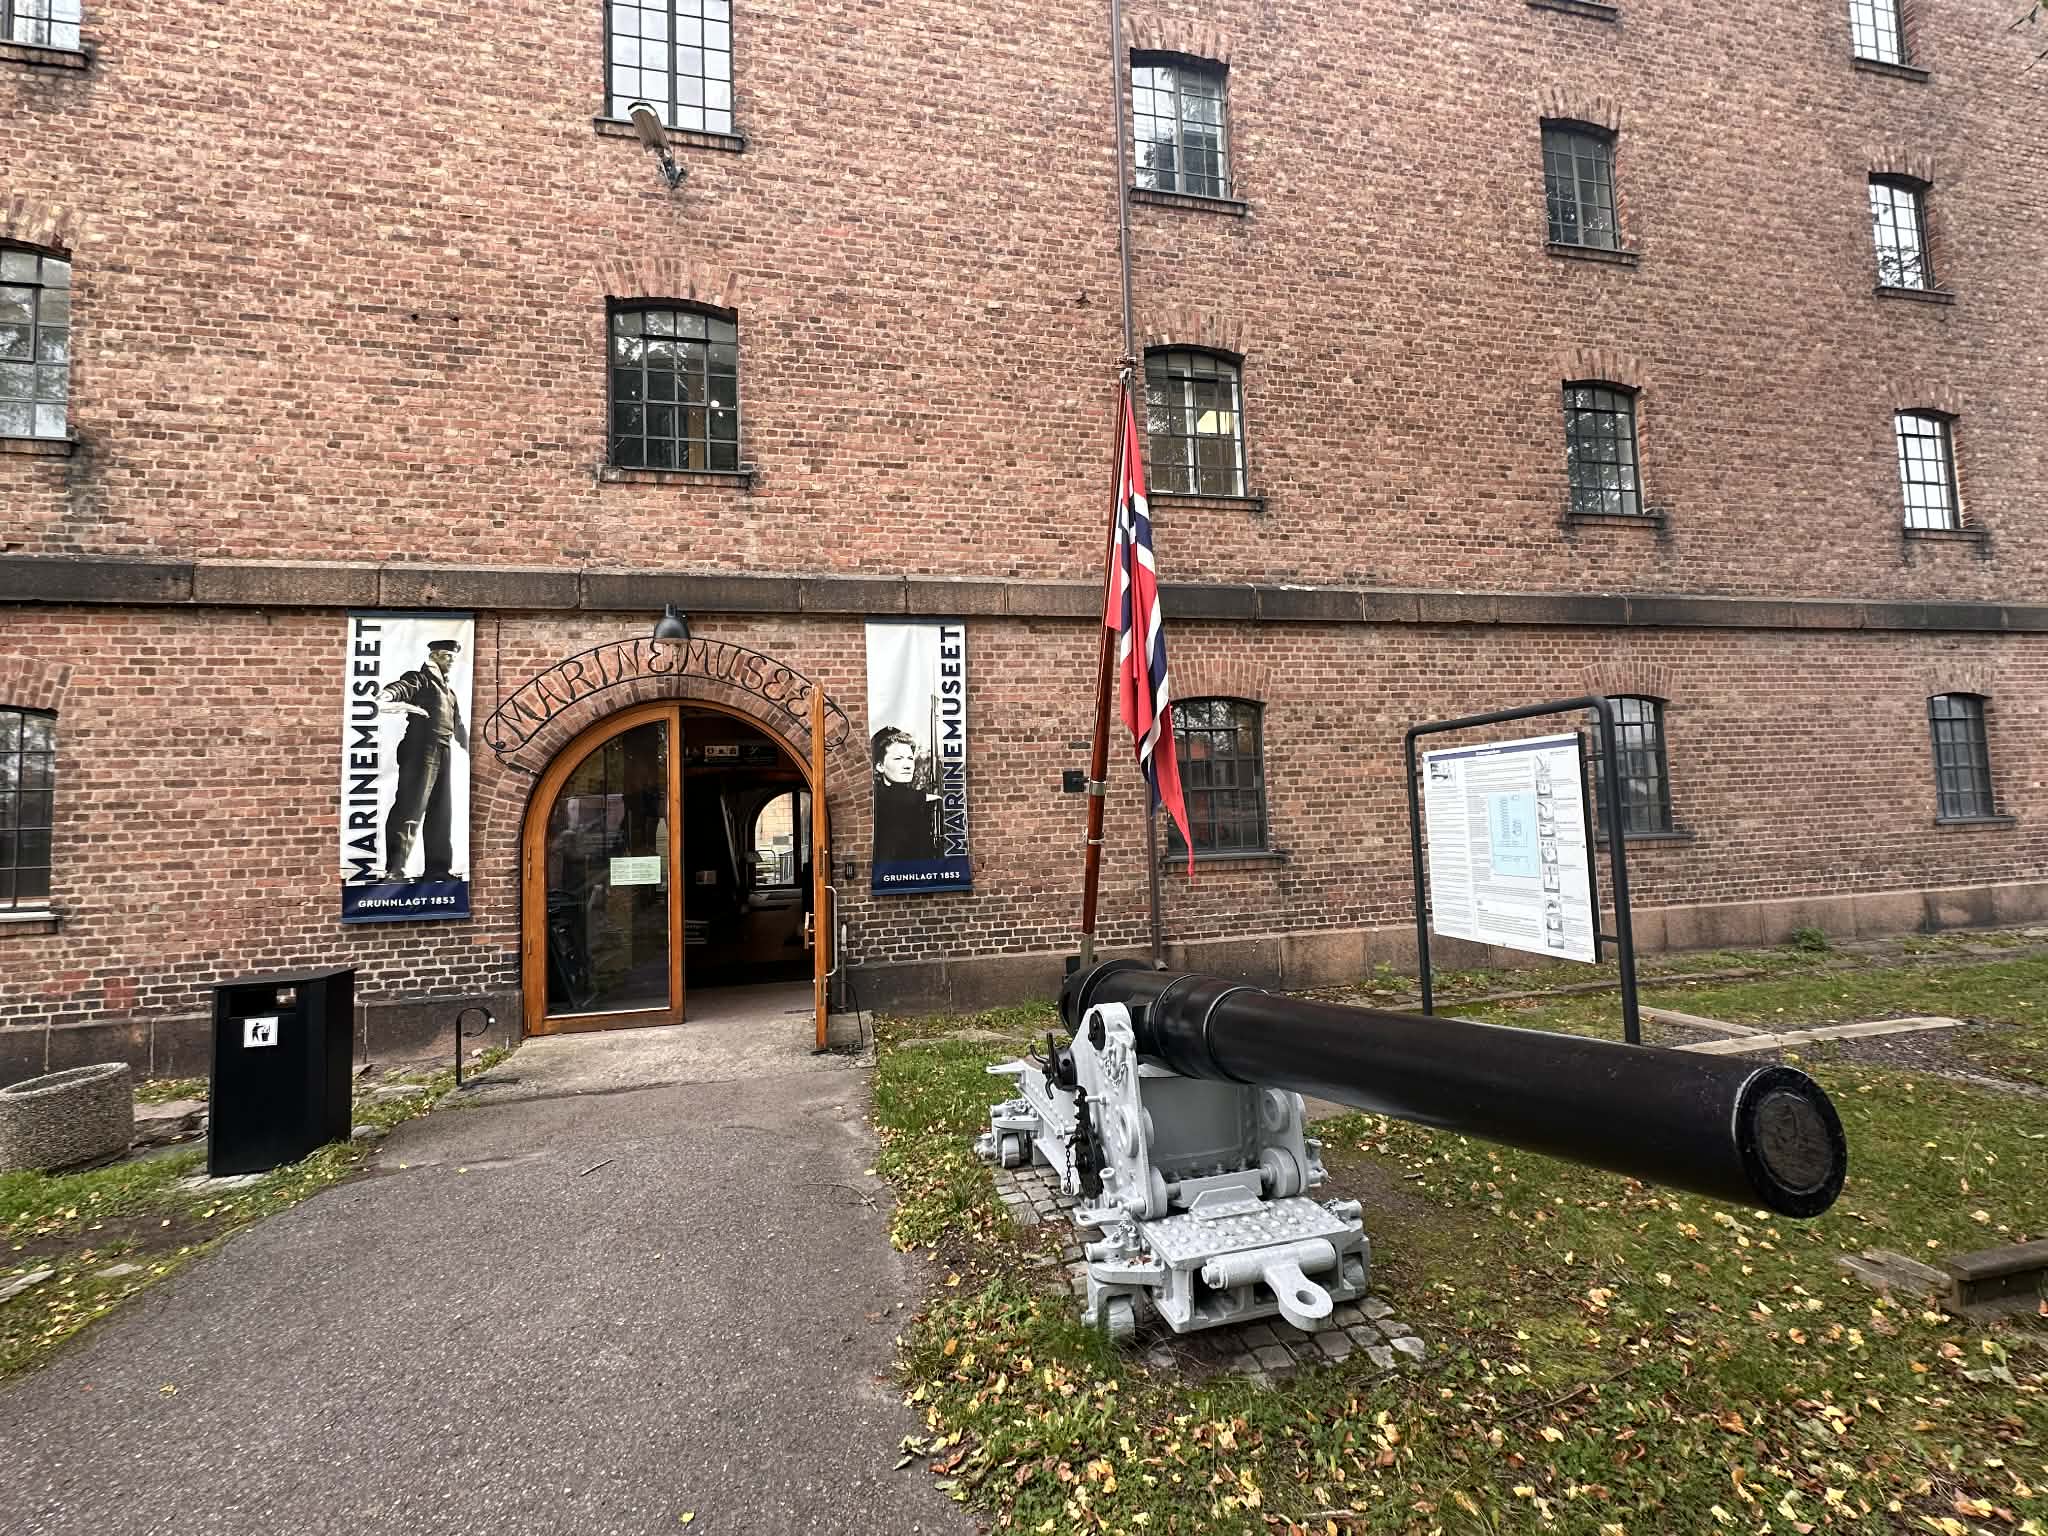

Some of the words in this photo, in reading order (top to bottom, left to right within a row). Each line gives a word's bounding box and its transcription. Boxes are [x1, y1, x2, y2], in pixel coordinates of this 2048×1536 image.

[347, 618, 382, 883] MARINEMUSEET
[940, 626, 968, 857] MARINEMUSEET
[358, 897, 427, 908] GRUNNLAGT
[430, 896, 455, 905] 1853
[883, 873, 937, 882] GRUNNLAGT
[940, 871, 960, 879] 1853
